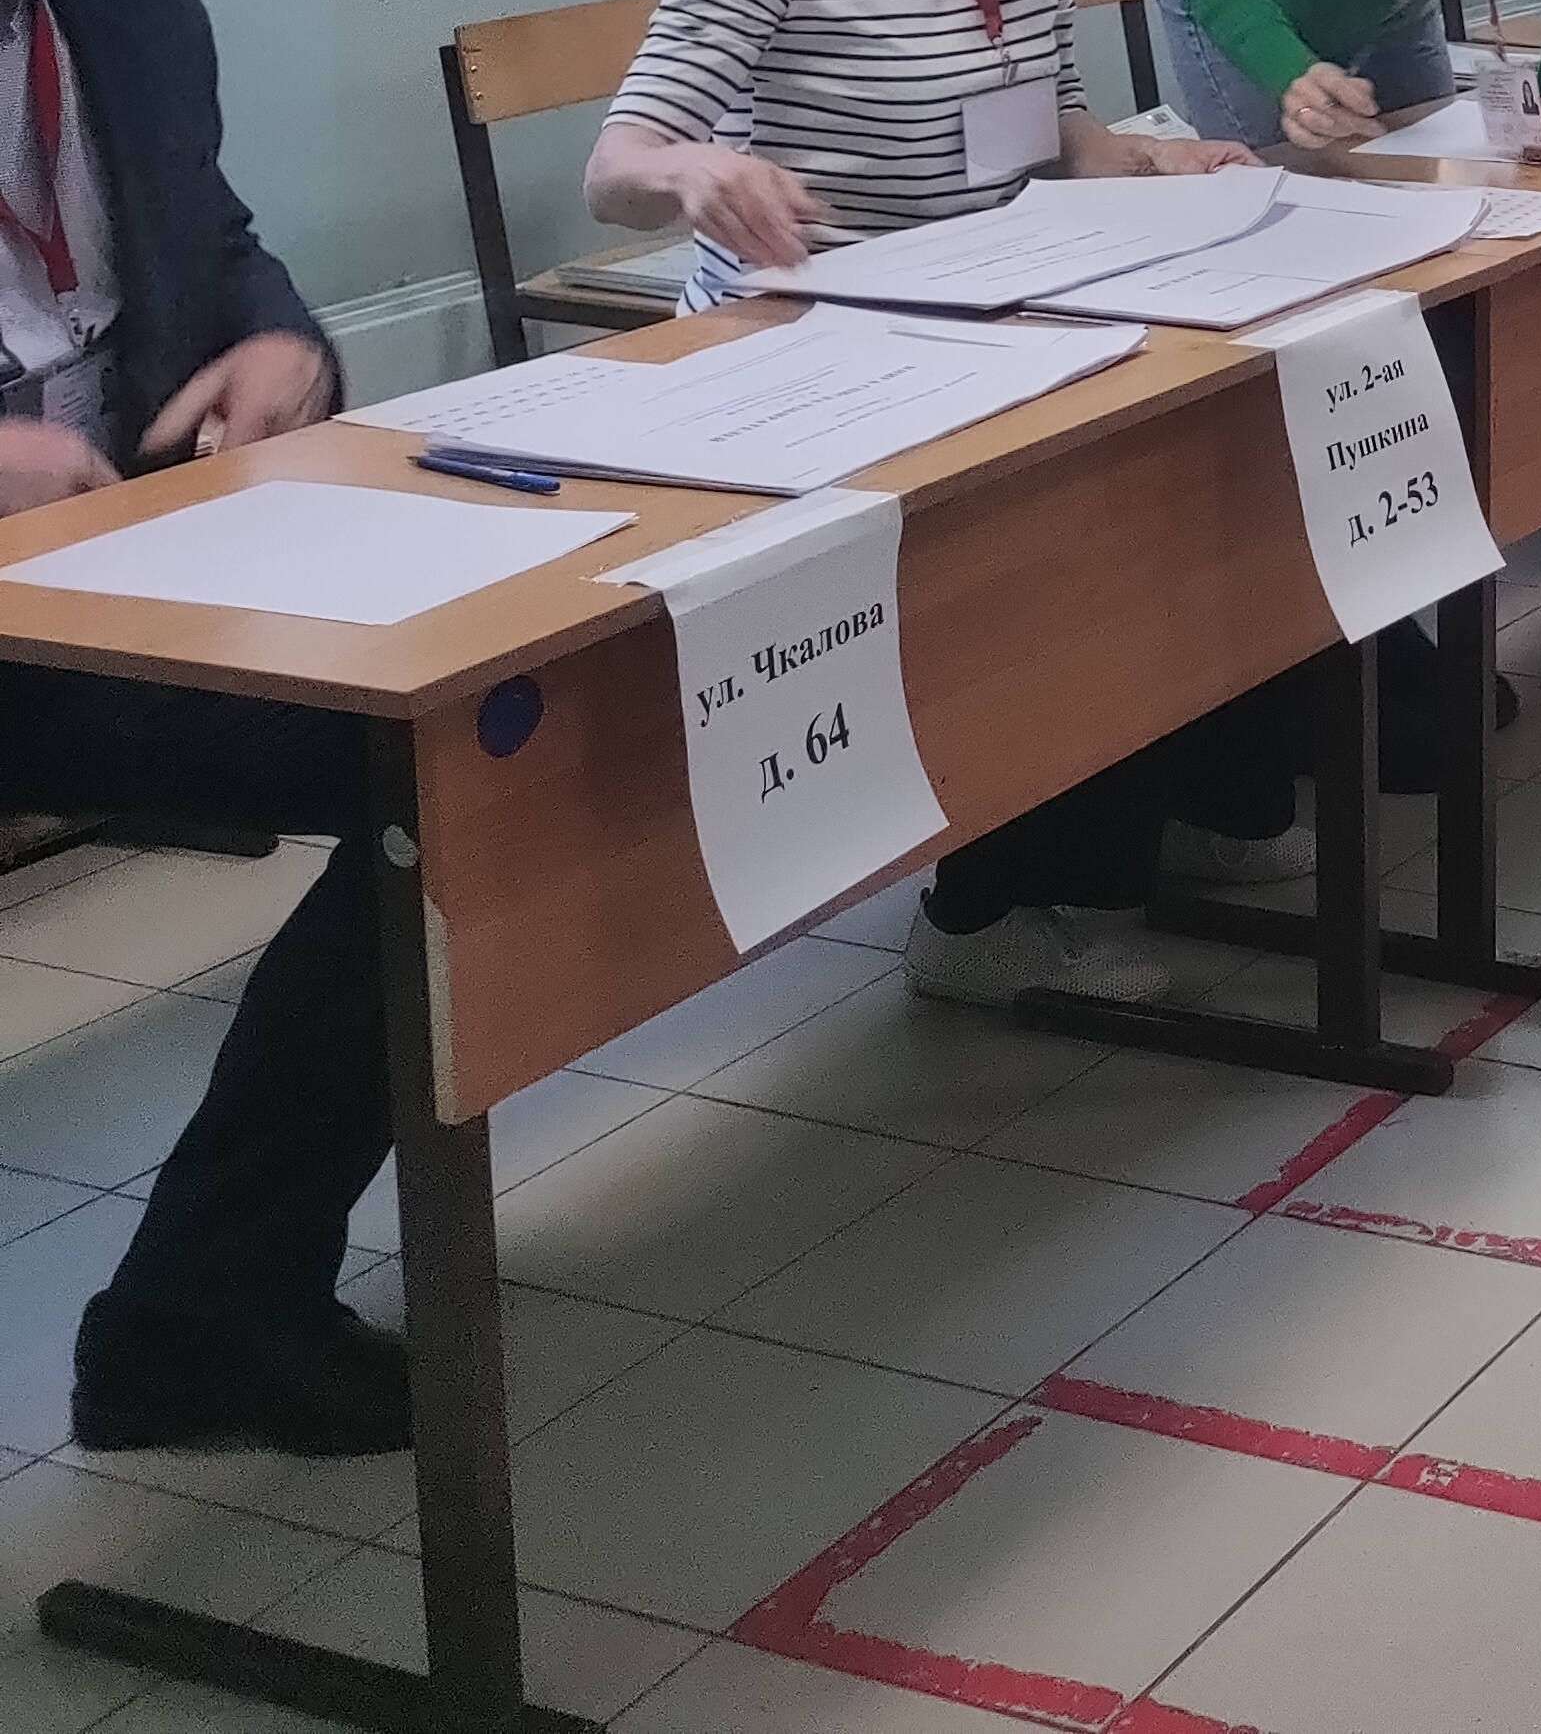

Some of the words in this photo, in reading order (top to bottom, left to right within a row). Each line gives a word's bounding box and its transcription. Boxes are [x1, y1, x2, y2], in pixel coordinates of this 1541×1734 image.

[1326, 380, 1358, 413] ул.
[1362, 358, 1405, 392] 2-ая
[1326, 413, 1430, 471] Пушкина
[1348, 514, 1374, 548] д.
[1378, 471, 1439, 527] 2-53
[697, 675, 744, 728] ул.
[751, 602, 885, 684] Чкалова
[759, 751, 794, 804] д.
[805, 702, 850, 764] 64
